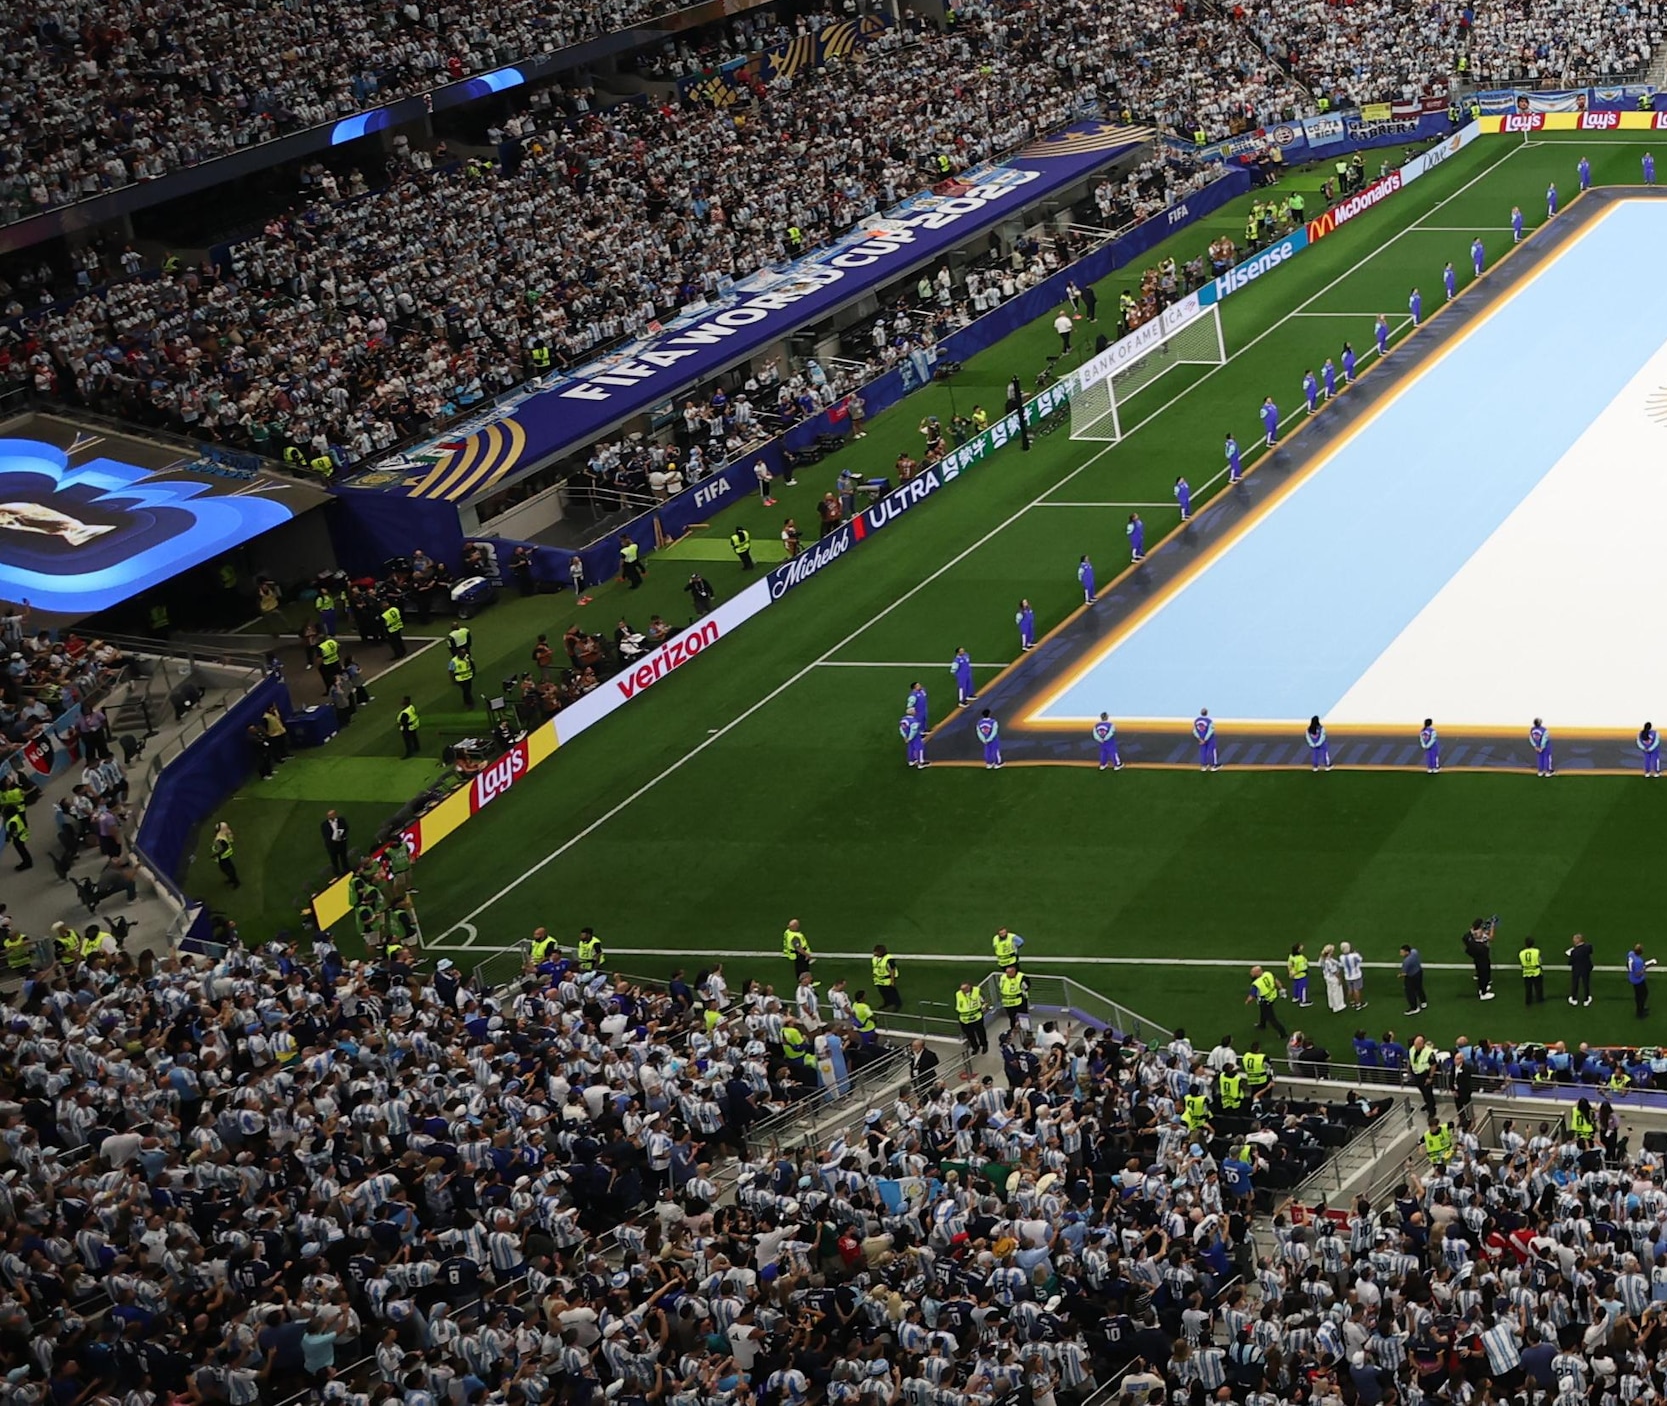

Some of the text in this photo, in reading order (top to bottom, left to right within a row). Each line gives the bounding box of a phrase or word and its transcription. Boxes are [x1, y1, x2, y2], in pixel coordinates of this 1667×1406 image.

[1505, 113, 1542, 133] Lay's
[1582, 112, 1618, 130] Lay's
[1168, 204, 1189, 224] FIFA
[1335, 173, 1400, 226] McDonald's
[1215, 241, 1294, 301] Hisense
[1085, 307, 1184, 383] BANK OF AMEICA
[559, 349, 700, 401] FIFA
[693, 477, 731, 508] FIFA
[772, 470, 942, 599] Michelob ULTRA
[617, 620, 720, 699] verizon
[478, 748, 524, 809] Lay's
[1224, 1171, 1240, 1184] 10
[449, 1271, 460, 1285] 8
[1104, 1326, 1121, 1343] 10
